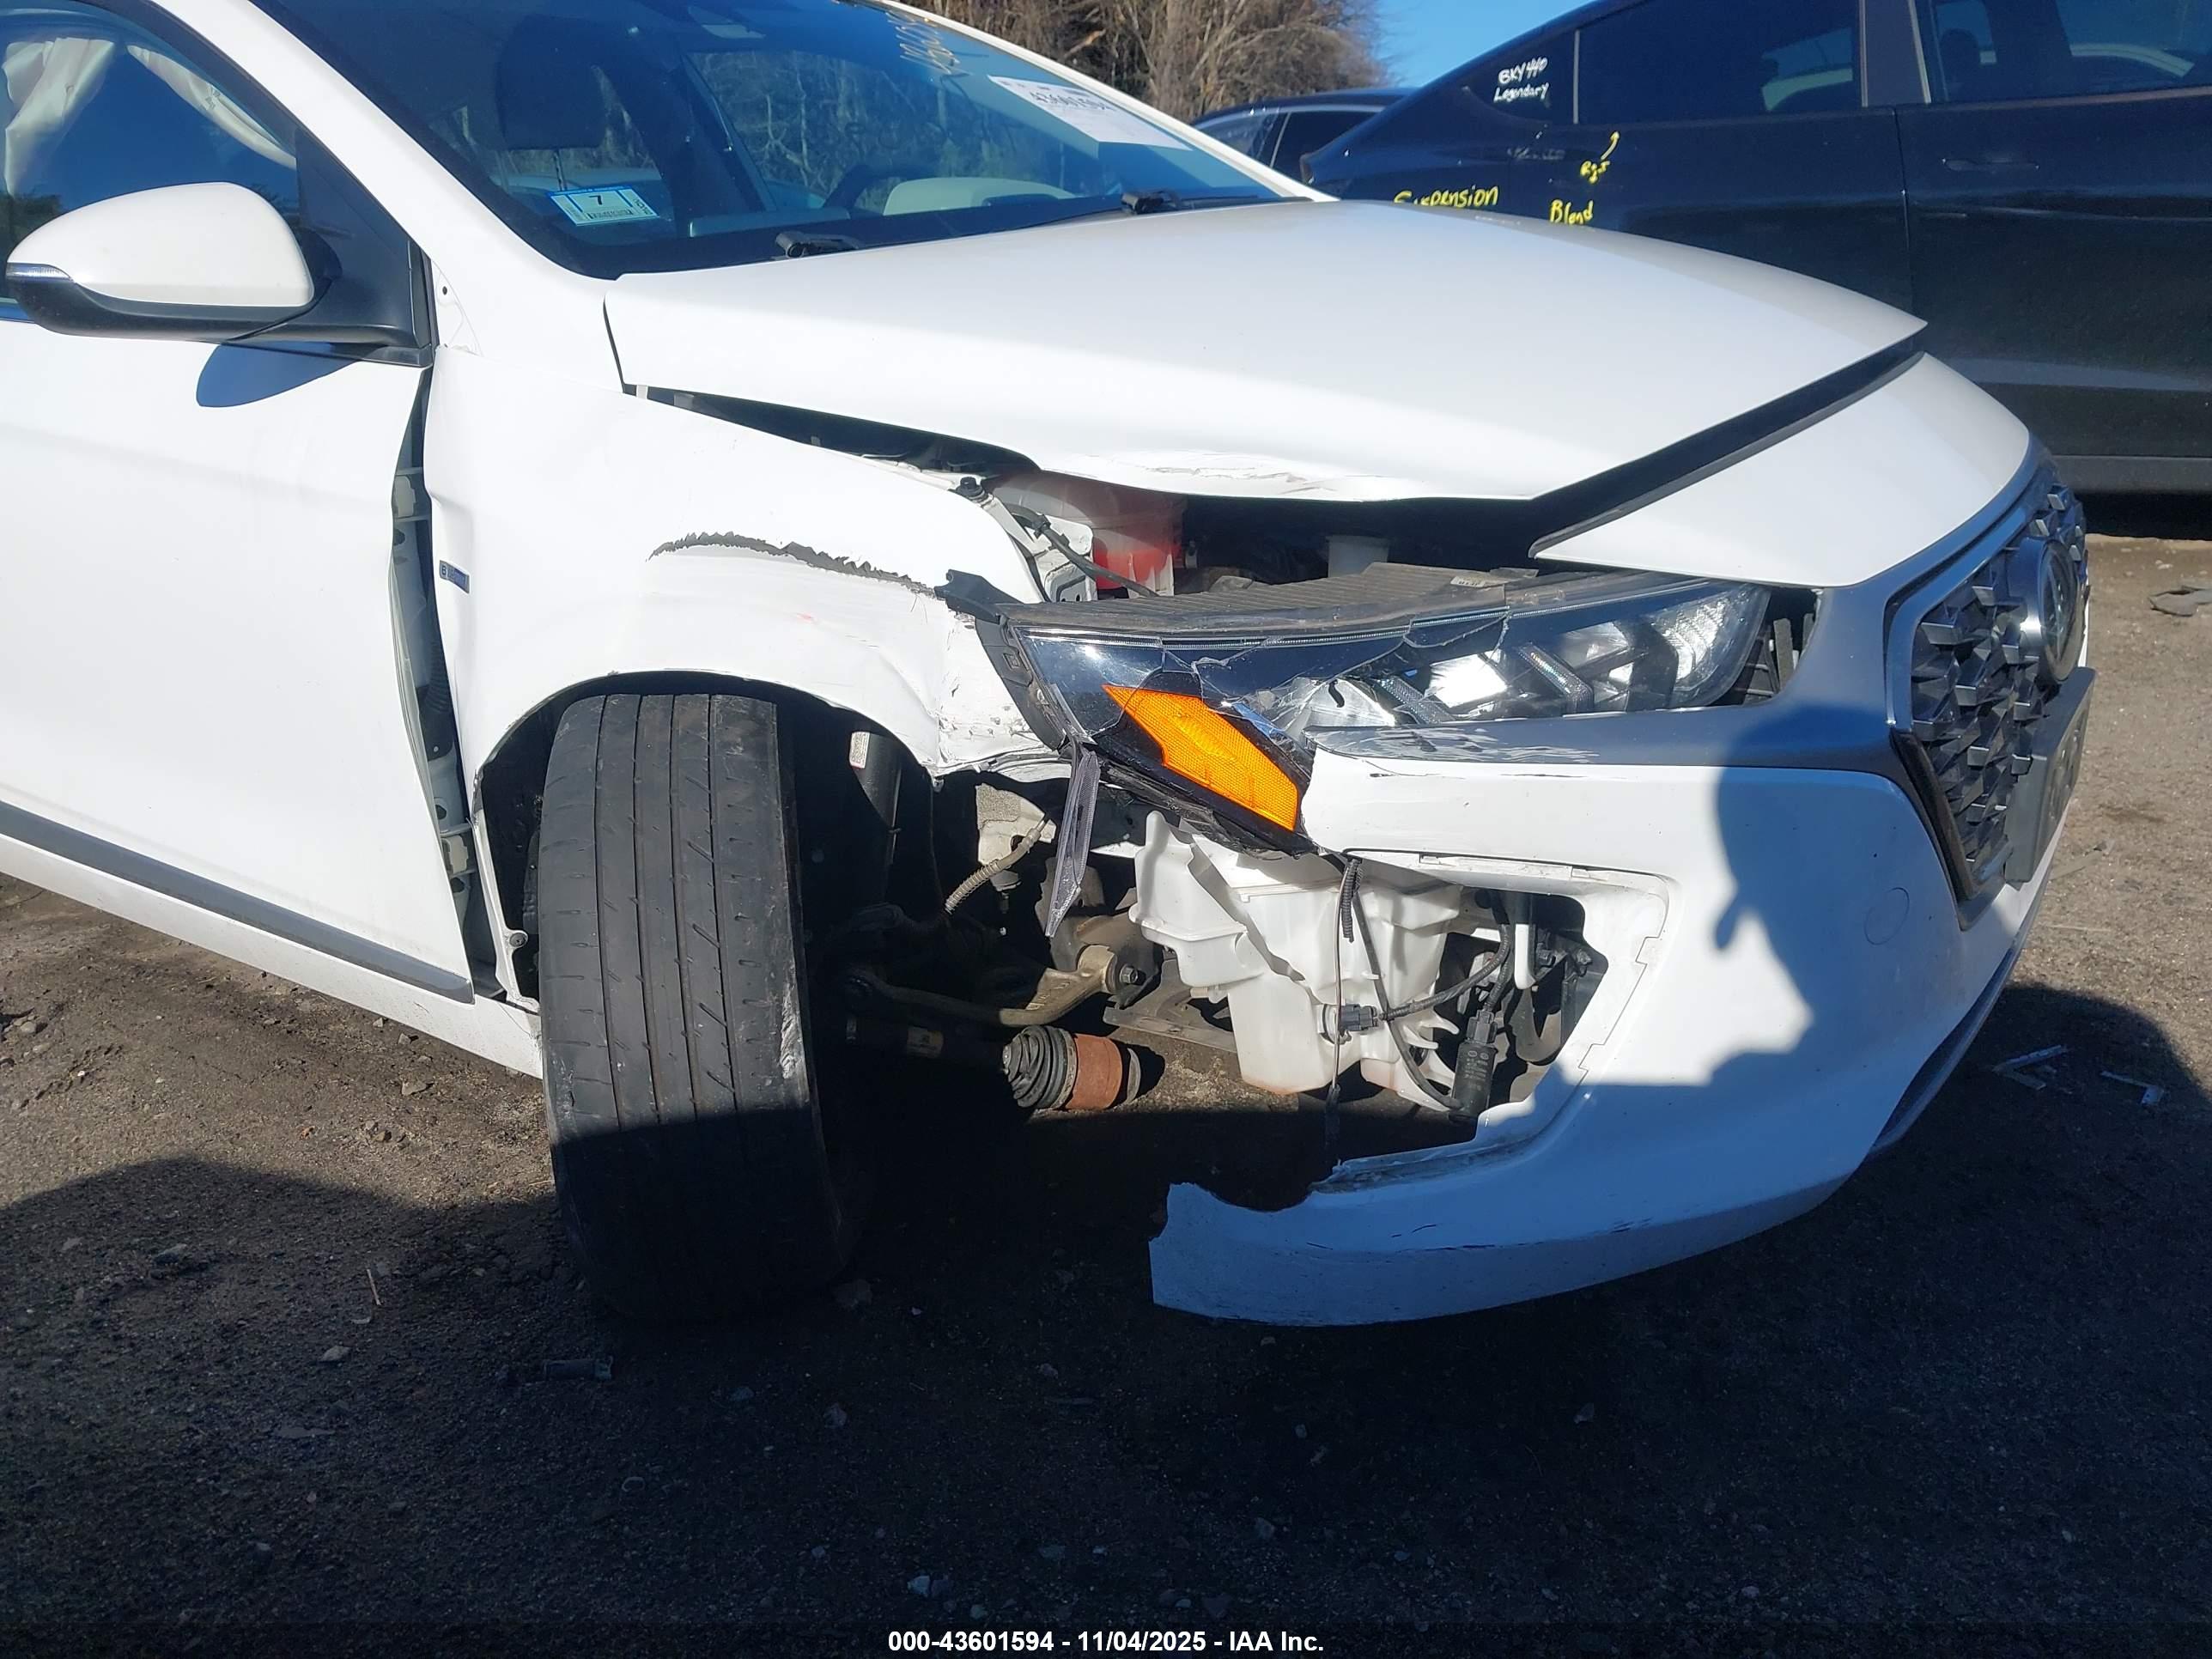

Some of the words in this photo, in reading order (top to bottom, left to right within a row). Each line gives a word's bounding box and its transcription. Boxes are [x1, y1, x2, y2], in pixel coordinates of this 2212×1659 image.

[1493, 82, 1549, 102] Legendary
[588, 195, 603, 205] 7
[1394, 185, 1498, 208] Sspension
[1550, 199, 1594, 224] Blend
